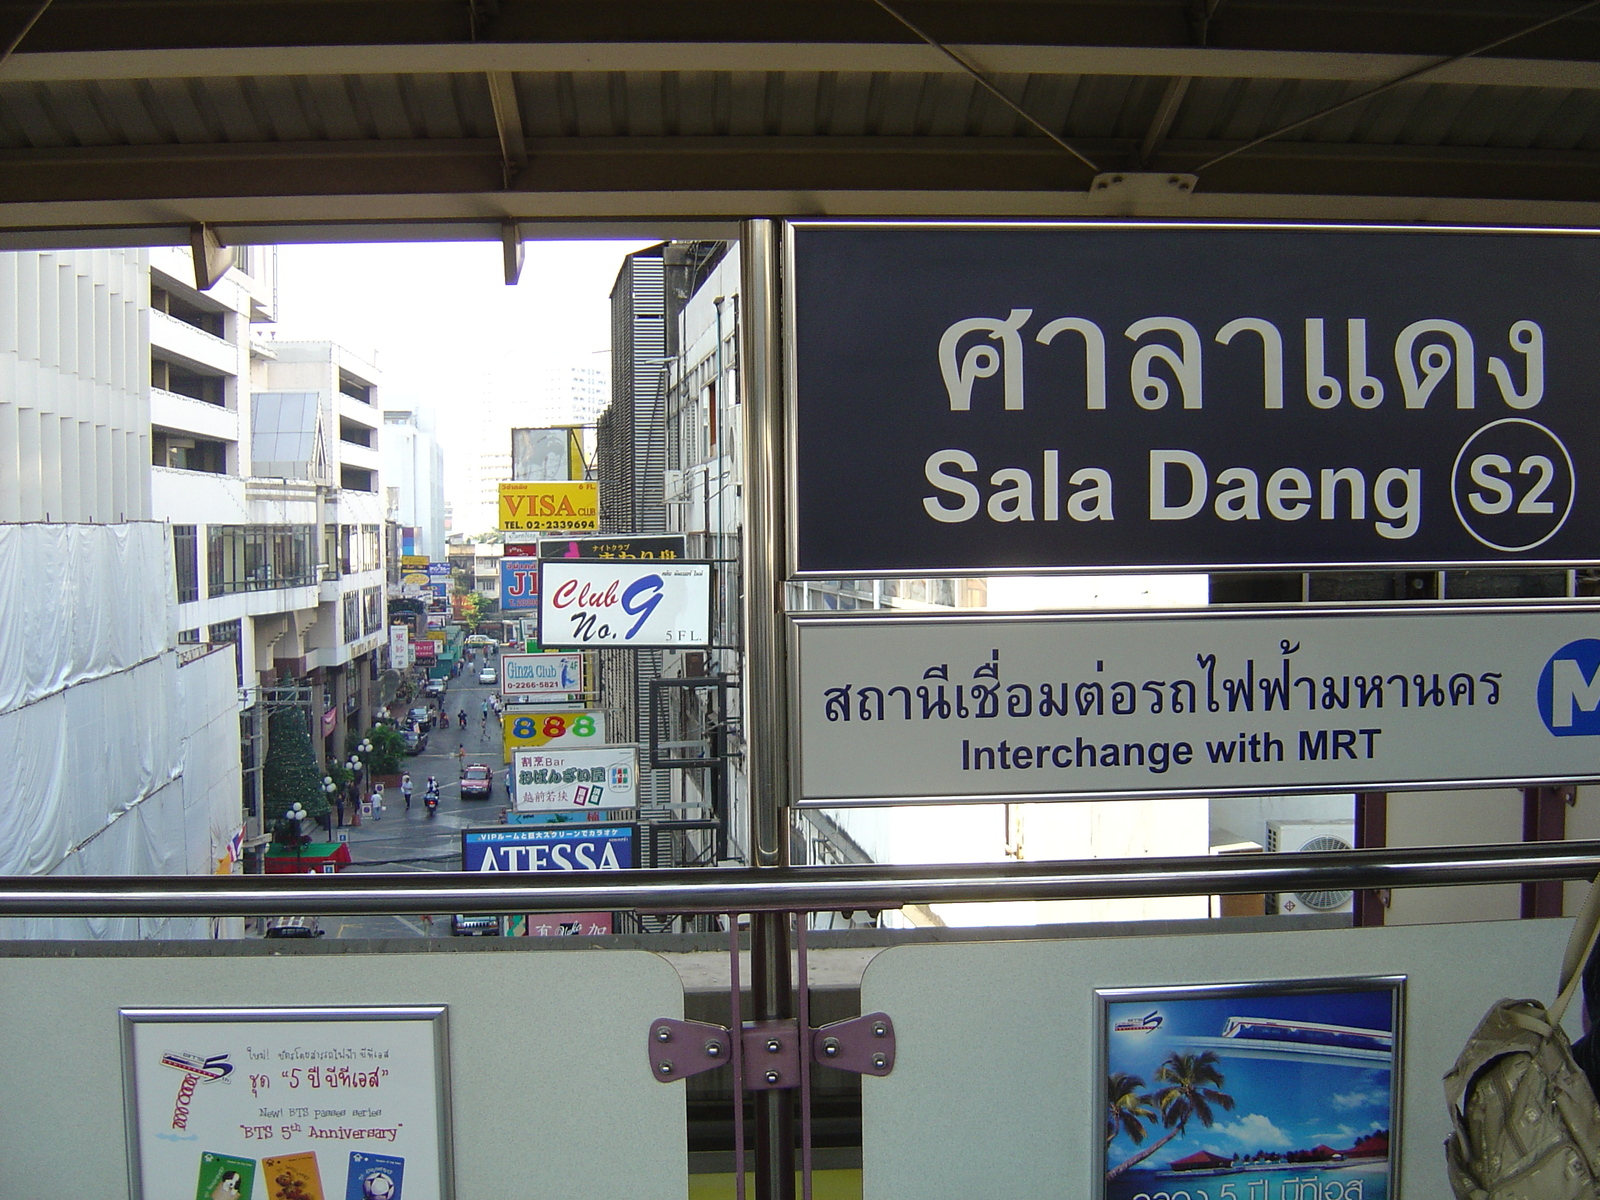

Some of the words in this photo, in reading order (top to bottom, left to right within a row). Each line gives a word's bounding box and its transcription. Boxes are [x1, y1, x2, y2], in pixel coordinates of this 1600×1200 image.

[937, 308, 1546, 412] ศาลาแดง
[503, 494, 576, 516] VISA
[578, 508, 596, 516] CLUB
[922, 447, 1115, 523] Sala
[1148, 447, 1423, 540] Daeng
[1467, 453, 1556, 516] S2
[505, 521, 523, 529] TEL.
[526, 520, 594, 529] 02-2339694
[592, 544, 631, 552] ナイトクラブ
[553, 579, 620, 608] Club
[570, 612, 616, 642] No.
[507, 662, 534, 678] Ginza
[536, 665, 556, 678] Club
[823, 639, 1503, 722] สถานีเชื่อมต่อรถไฟฟ้ามหานคร
[961, 731, 1194, 775] Interchange
[1207, 732, 1285, 763] with
[1298, 728, 1382, 762] MRT
[518, 767, 606, 785] おばんざい屋
[480, 842, 620, 872] ATESSA
[250, 1074, 270, 1098] ชุด
[308, 1066, 320, 1088] ปี
[325, 1066, 389, 1088] บีทีเอส”
[259, 1108, 284, 1118] New!
[288, 1108, 308, 1118] BTS
[314, 1110, 346, 1120] passes
[352, 1109, 382, 1118] series
[281, 1122, 302, 1140] 5th
